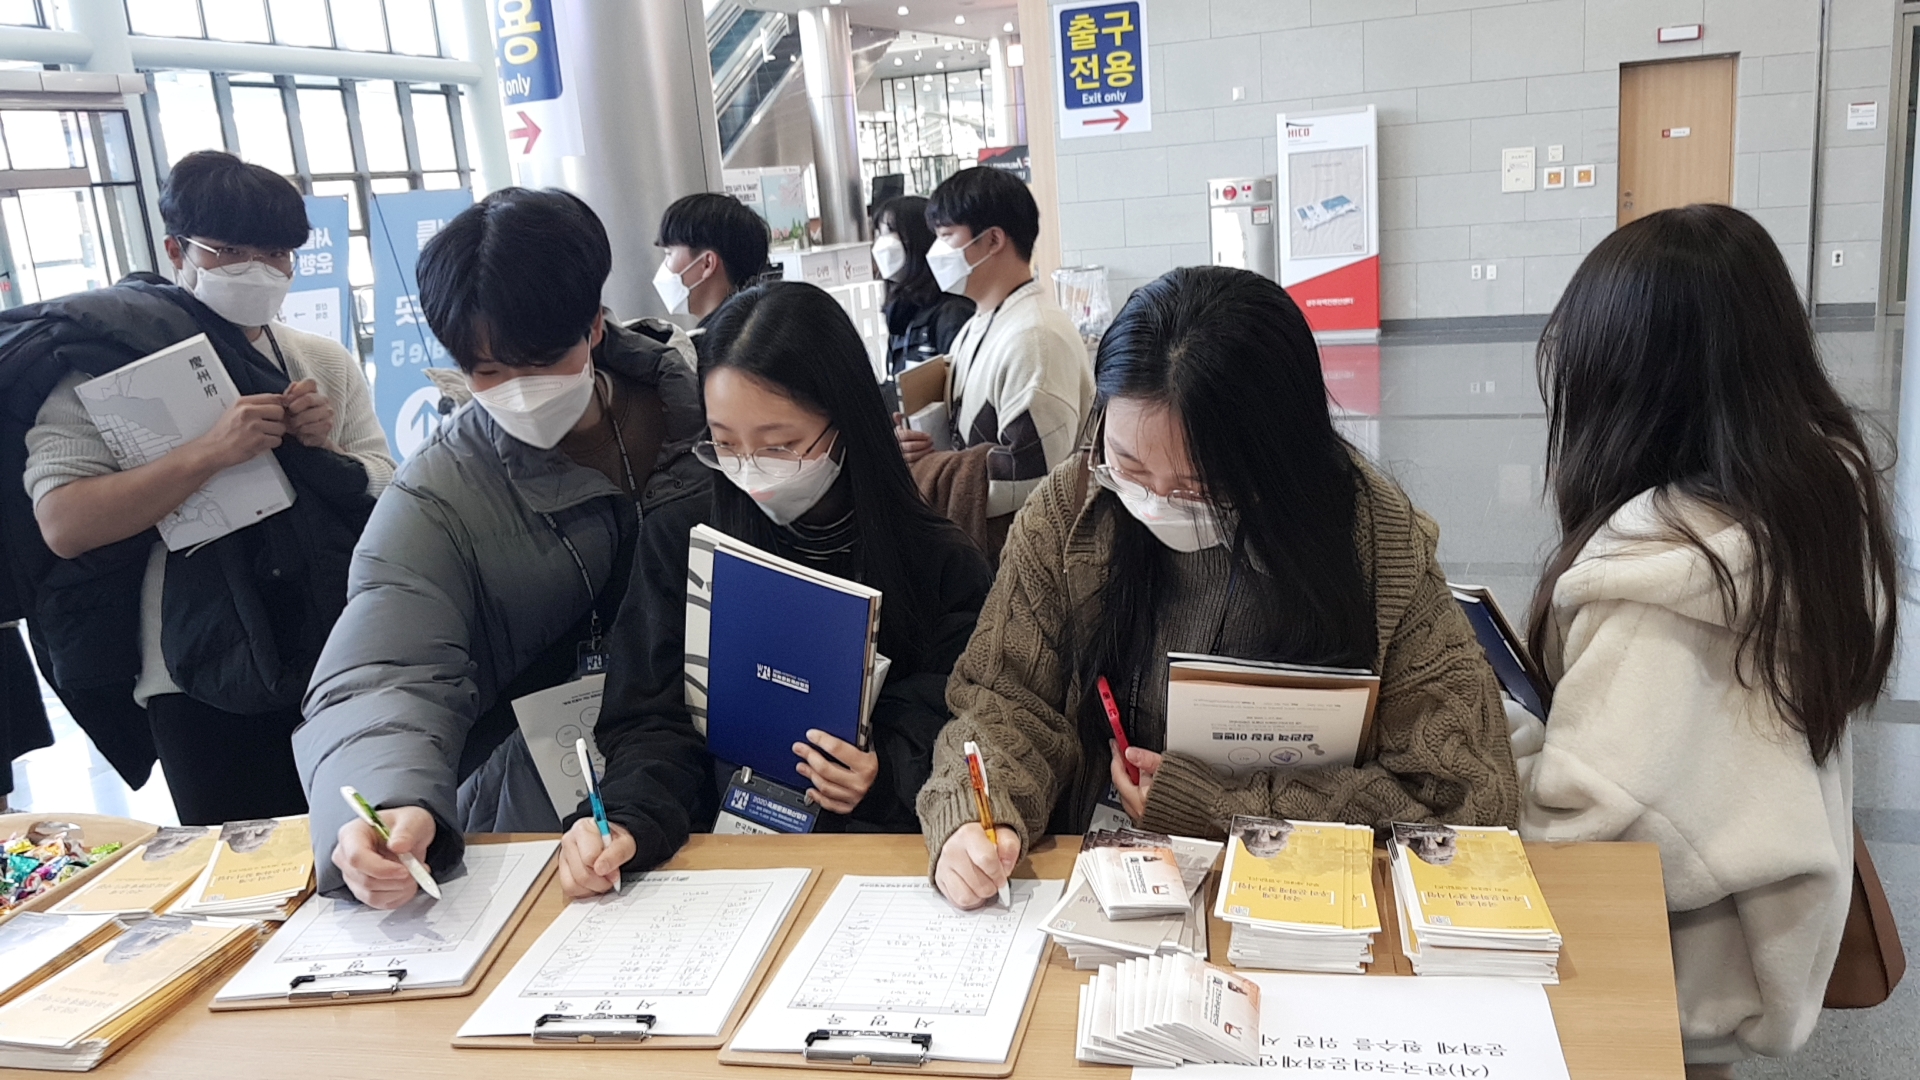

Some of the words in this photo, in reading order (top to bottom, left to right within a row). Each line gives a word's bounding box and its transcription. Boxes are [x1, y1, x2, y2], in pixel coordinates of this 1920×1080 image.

[495, 0, 542, 65] 용
[1067, 10, 1134, 51] 출구
[1069, 50, 1136, 90] 전용
[506, 73, 531, 97] only
[1082, 92, 1102, 105] Exit
[1104, 90, 1127, 103] only
[1288, 127, 1310, 138] HICO
[188, 355, 218, 398] 慶州府
[636, 999, 657, 1011] 서
[914, 1016, 935, 1029] 서
[1261, 1033, 1281, 1047] 서
[1293, 1034, 1339, 1050] 위한
[1352, 1036, 1423, 1054] 환수를
[1437, 1041, 1508, 1057] 문화재
[1258, 1053, 1490, 1078] (사)한국국외문화재연
